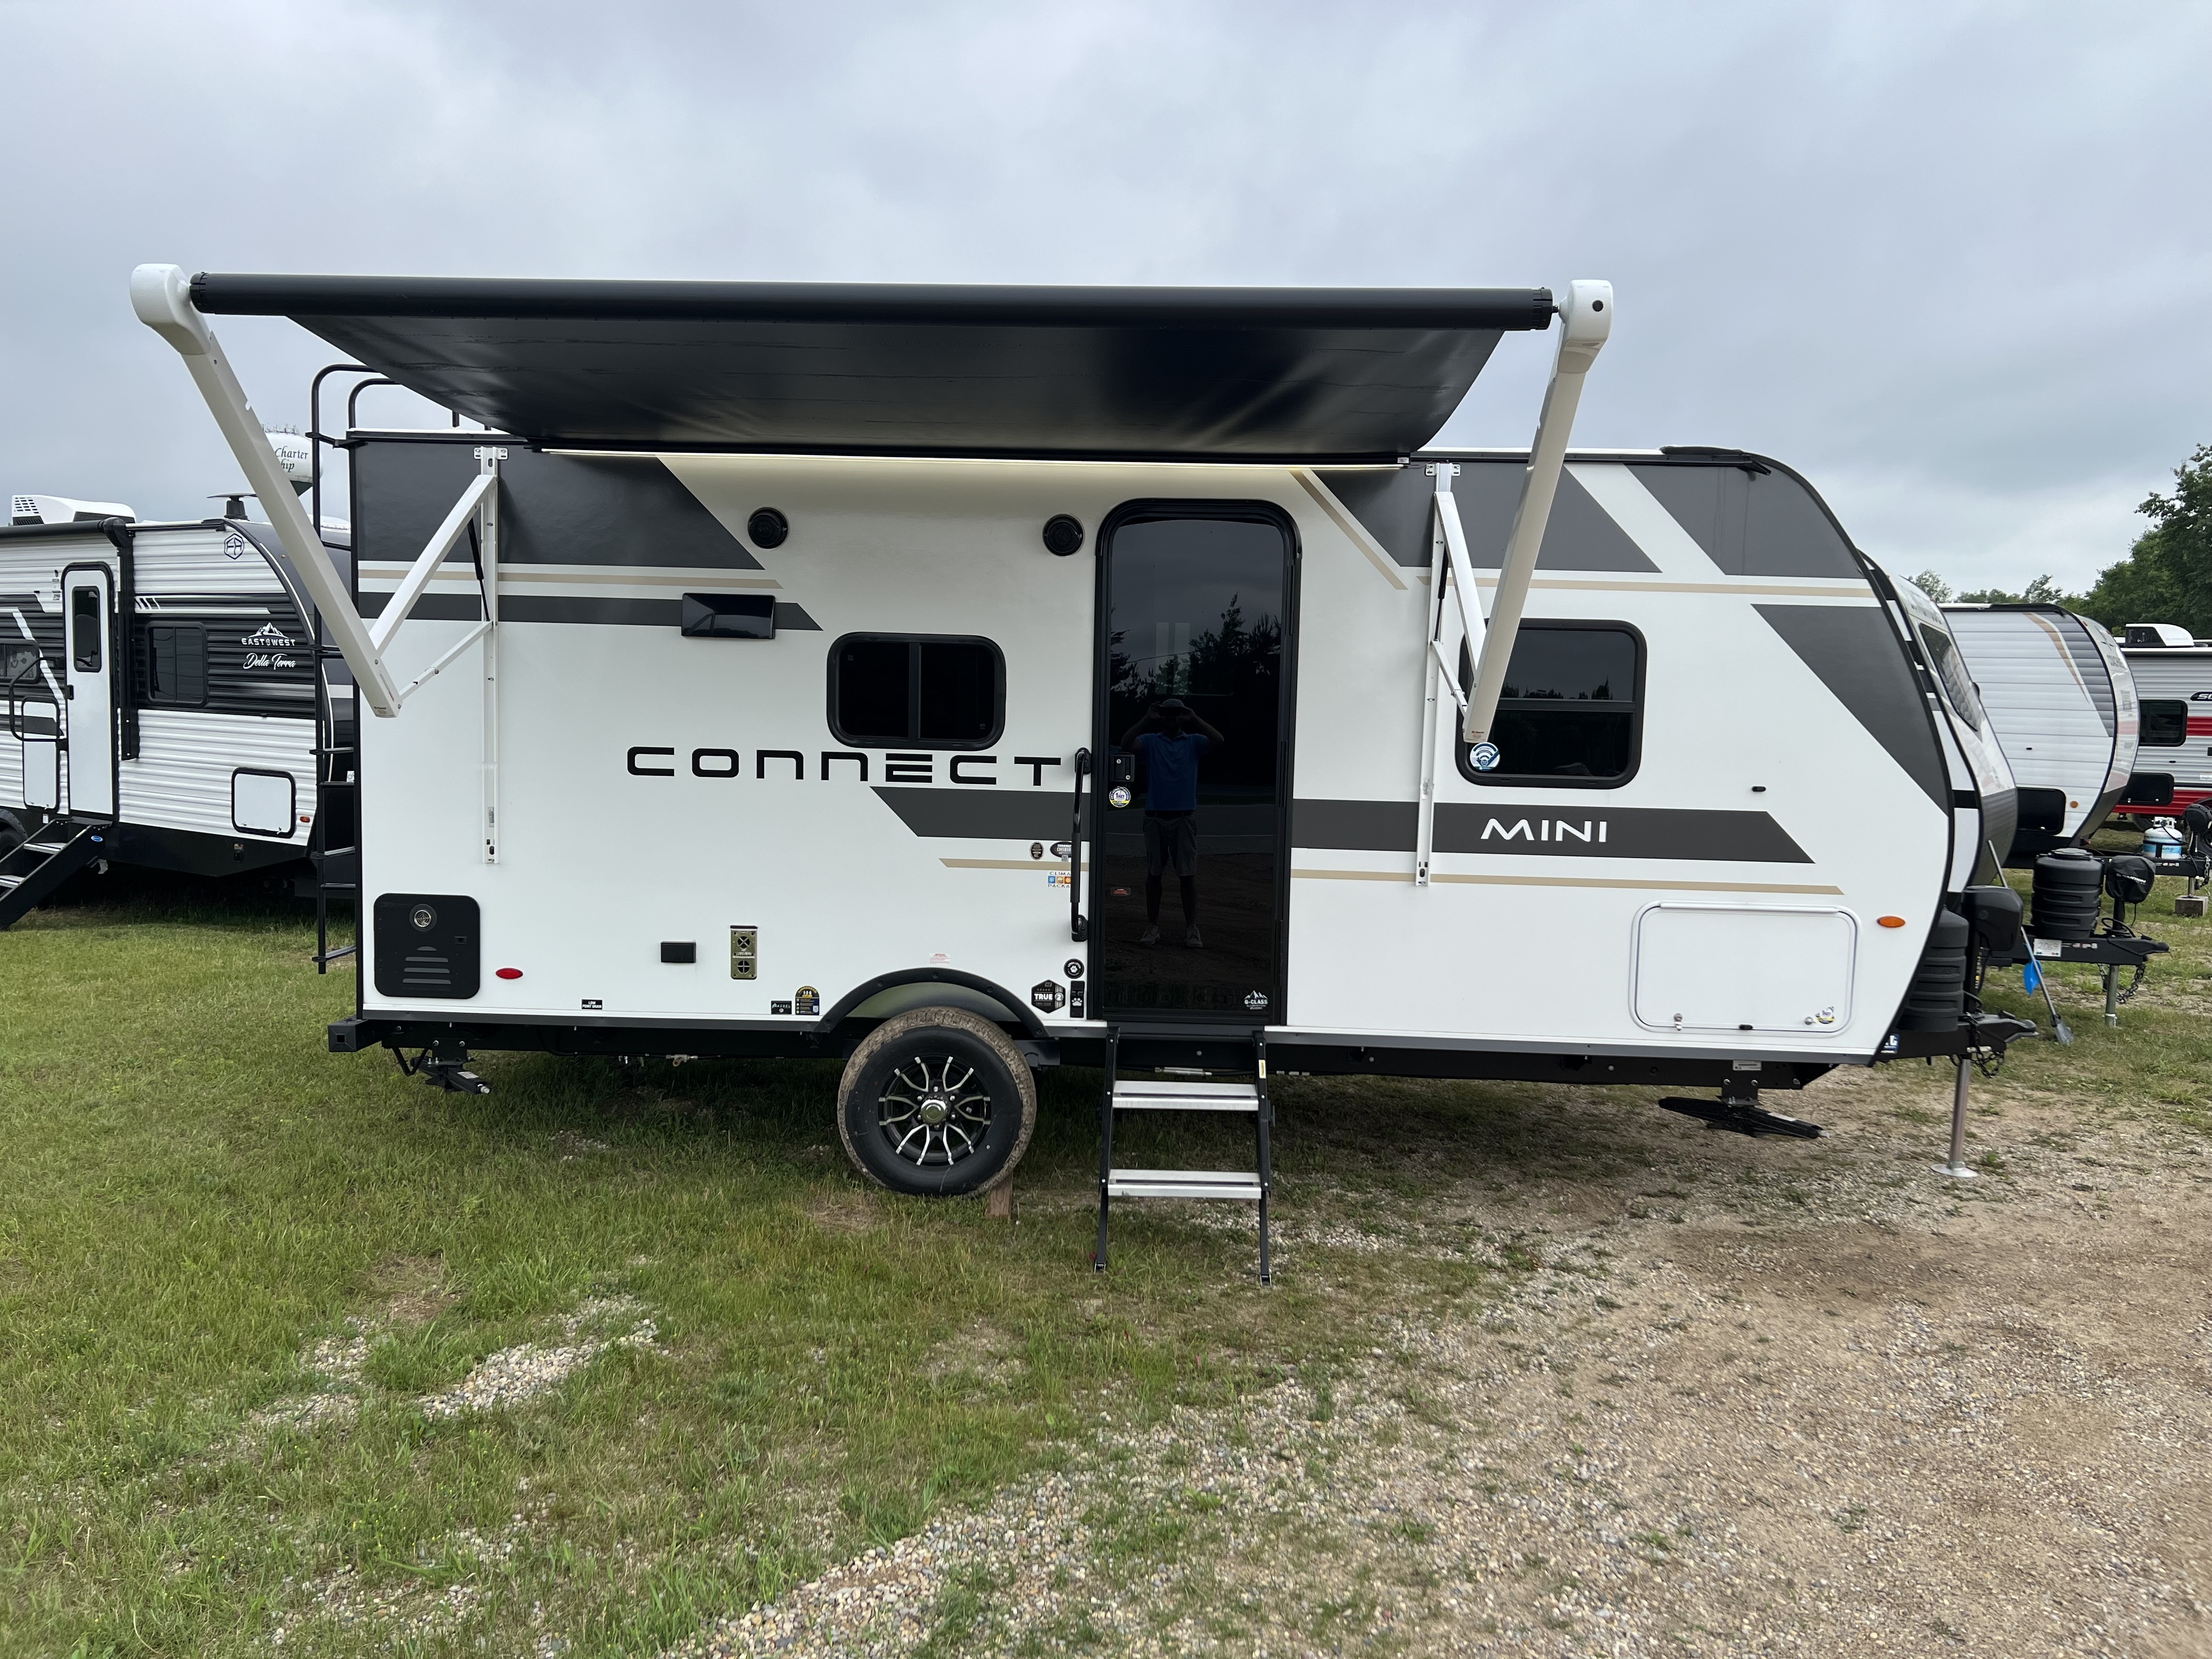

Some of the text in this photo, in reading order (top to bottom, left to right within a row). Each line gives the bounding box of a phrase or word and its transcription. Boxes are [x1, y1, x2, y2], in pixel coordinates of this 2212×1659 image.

[275, 445, 308, 459] Charter
[280, 459, 295, 473] hip
[241, 637, 264, 646] EAST
[243, 652, 296, 670] Della Terra
[627, 746, 1062, 786] CONNECT
[1481, 818, 1607, 843] MINI
